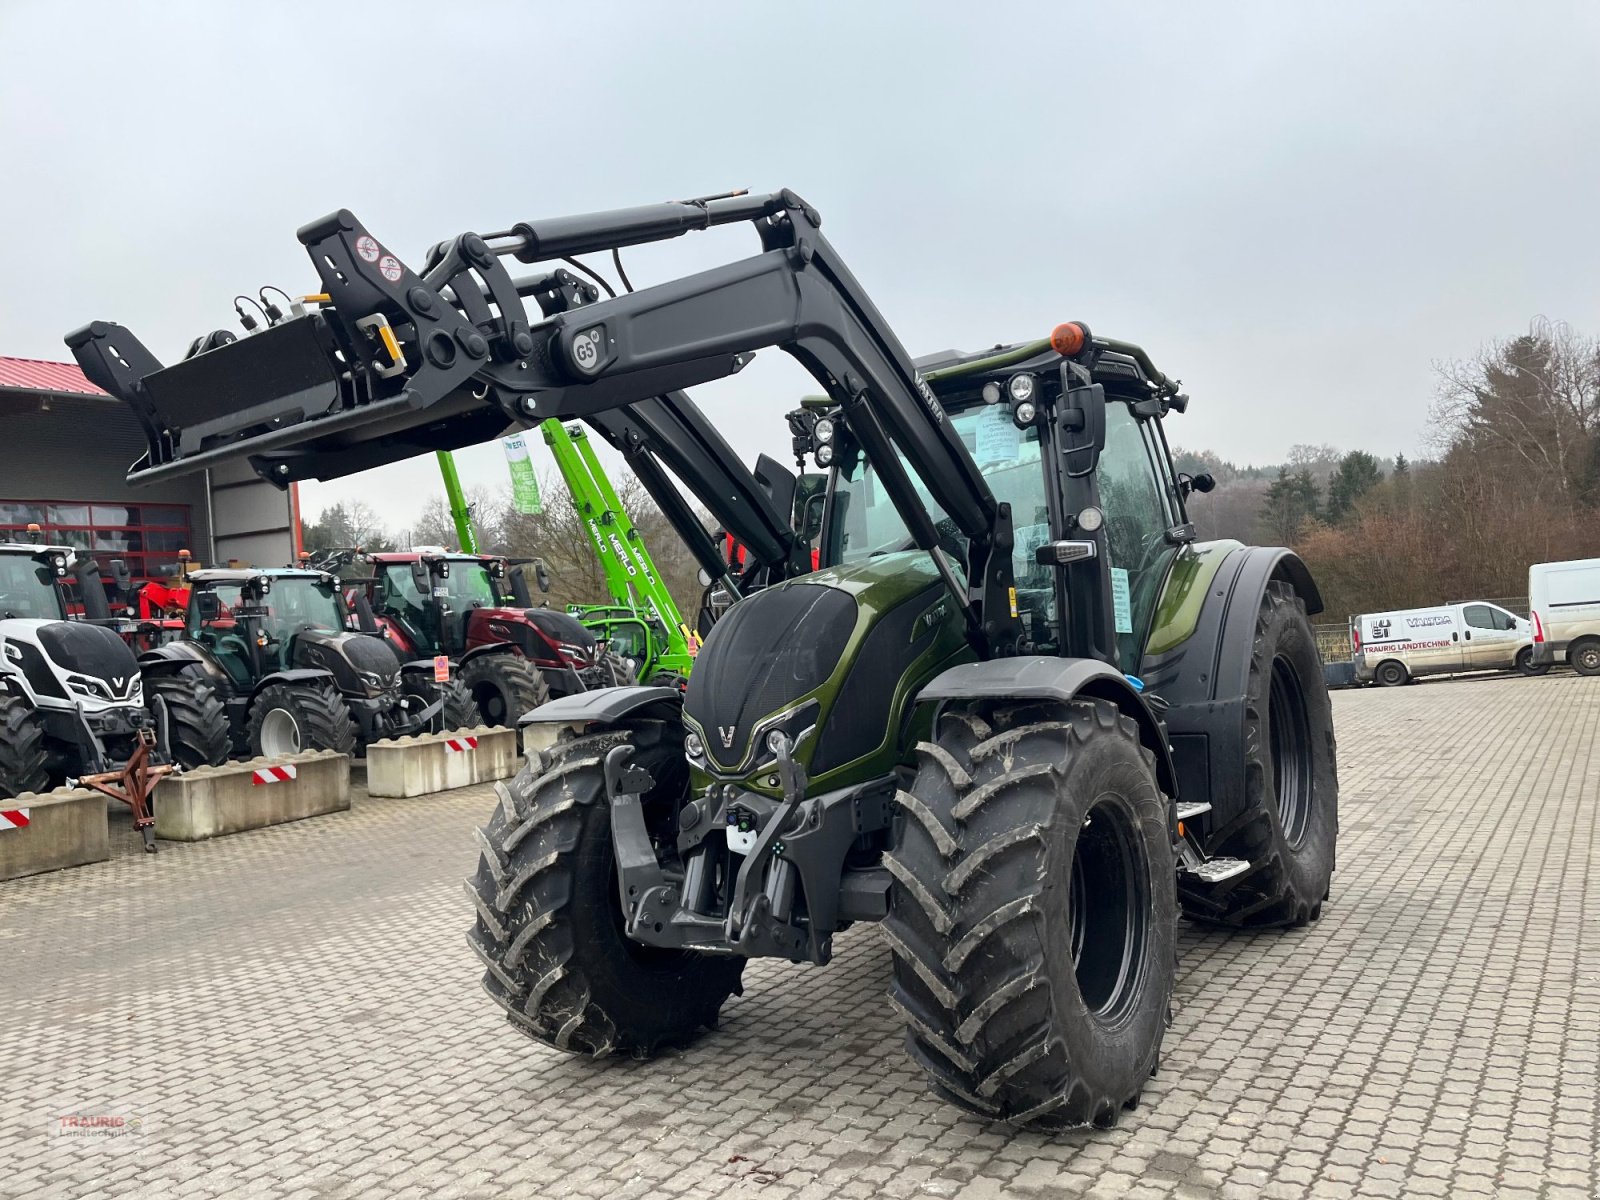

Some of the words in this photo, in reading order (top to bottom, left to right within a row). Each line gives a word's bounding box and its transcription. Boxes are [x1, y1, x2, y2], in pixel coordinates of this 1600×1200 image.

[576, 341, 594, 361] G5
[588, 518, 607, 553] MERLO
[608, 533, 637, 576] MERLO
[632, 546, 656, 585] MERLO
[1364, 644, 1396, 654] TRAURIG
[1397, 639, 1452, 651] LANDTECHNIK
